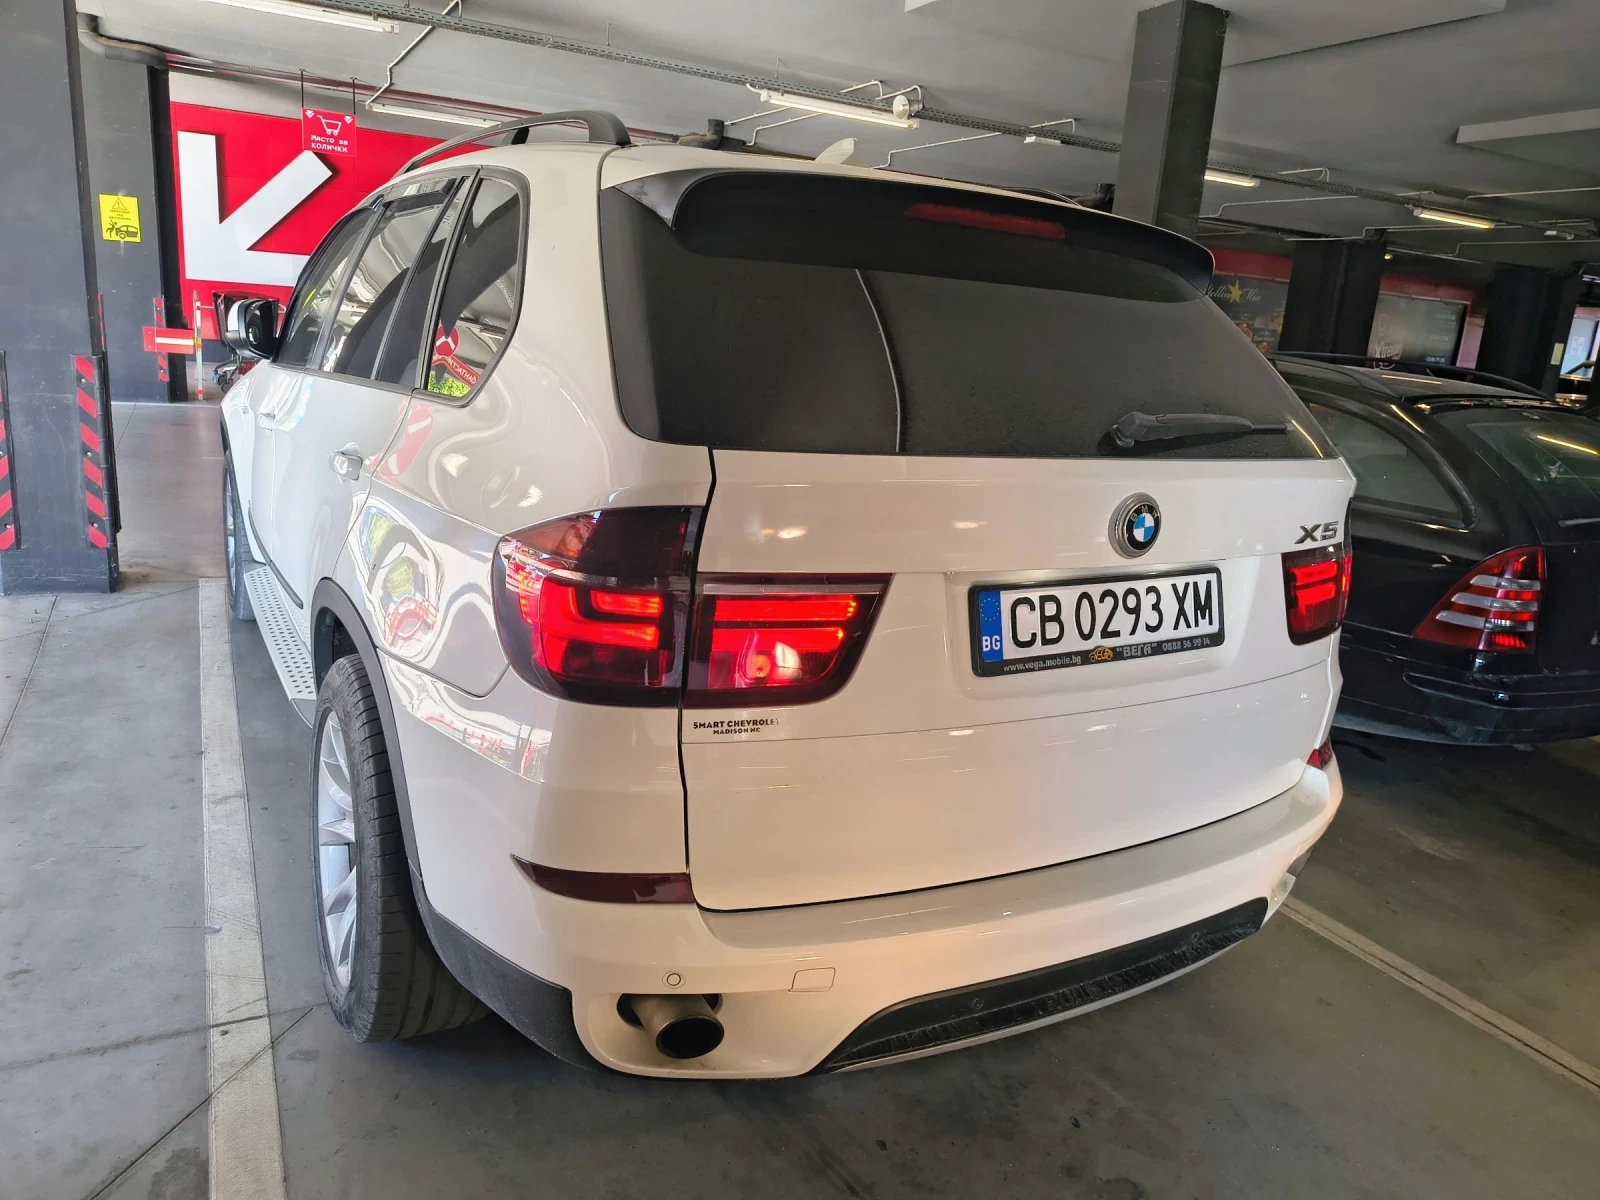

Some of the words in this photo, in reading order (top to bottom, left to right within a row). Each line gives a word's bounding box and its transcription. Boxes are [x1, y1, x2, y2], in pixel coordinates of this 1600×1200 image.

[311, 134, 335, 143] Място
[311, 142, 348, 152] КОЛИЧКИ
[1130, 505, 1160, 521] BMW
[1293, 521, 1339, 545] X5
[1010, 594, 1064, 648] CB
[1075, 585, 1164, 642] 0293
[1171, 580, 1213, 631] XM
[982, 635, 1001, 652] BG
[1162, 641, 1182, 652] 0888
[1183, 640, 1192, 649] 56
[1193, 638, 1202, 647] 99
[1203, 637, 1211, 645] 14
[1003, 655, 1081, 672] www.vega.mobile.bg
[693, 720, 725, 729] SMART
